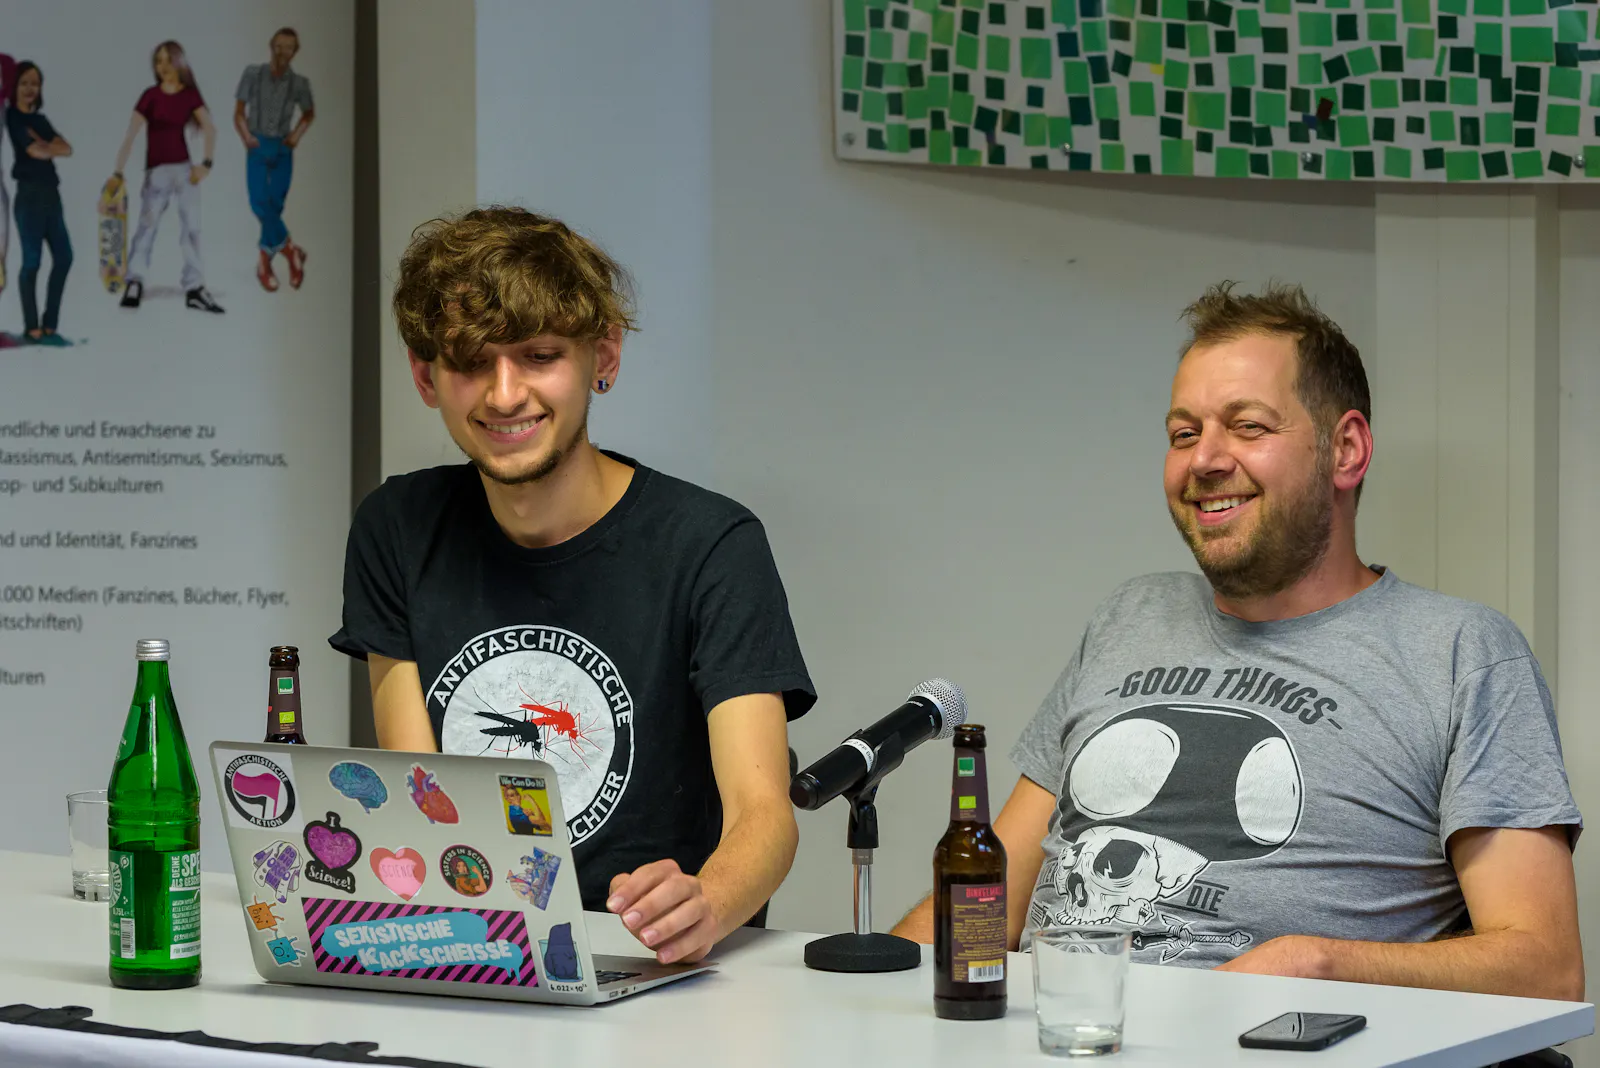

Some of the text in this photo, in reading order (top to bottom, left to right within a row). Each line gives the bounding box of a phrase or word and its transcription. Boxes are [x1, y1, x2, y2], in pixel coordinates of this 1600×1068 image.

[0, 419, 216, 439] ndliche und Erwachsene zu
[82, 449, 206, 468] Antisemitismus,
[211, 450, 288, 469] Sexismus,
[33, 476, 64, 493] und
[68, 476, 164, 494] Subkulturen
[20, 531, 51, 549] und
[55, 531, 125, 550] Identität,
[130, 532, 198, 550] Fanzines
[38, 586, 98, 604] Medien
[103, 586, 178, 608] (Fanzines,
[184, 587, 242, 607] Bücher,
[247, 588, 290, 609] Flyer,
[433, 630, 631, 728] ANTIFASCHISTISCHE
[225, 755, 289, 783] ANTIFASCHISTISCHE
[511, 777, 525, 787] Can
[525, 778, 536, 788] Do
[249, 816, 284, 827] AKTION
[171, 855, 181, 879] DEINE
[442, 849, 456, 877] SISTERS
[467, 849, 490, 880] SCIENCE
[308, 865, 352, 891] Science!
[1186, 885, 1226, 912] DIE
[334, 919, 454, 949] SEXISTISCHE
[357, 940, 513, 970] KACKSCHEISSE
